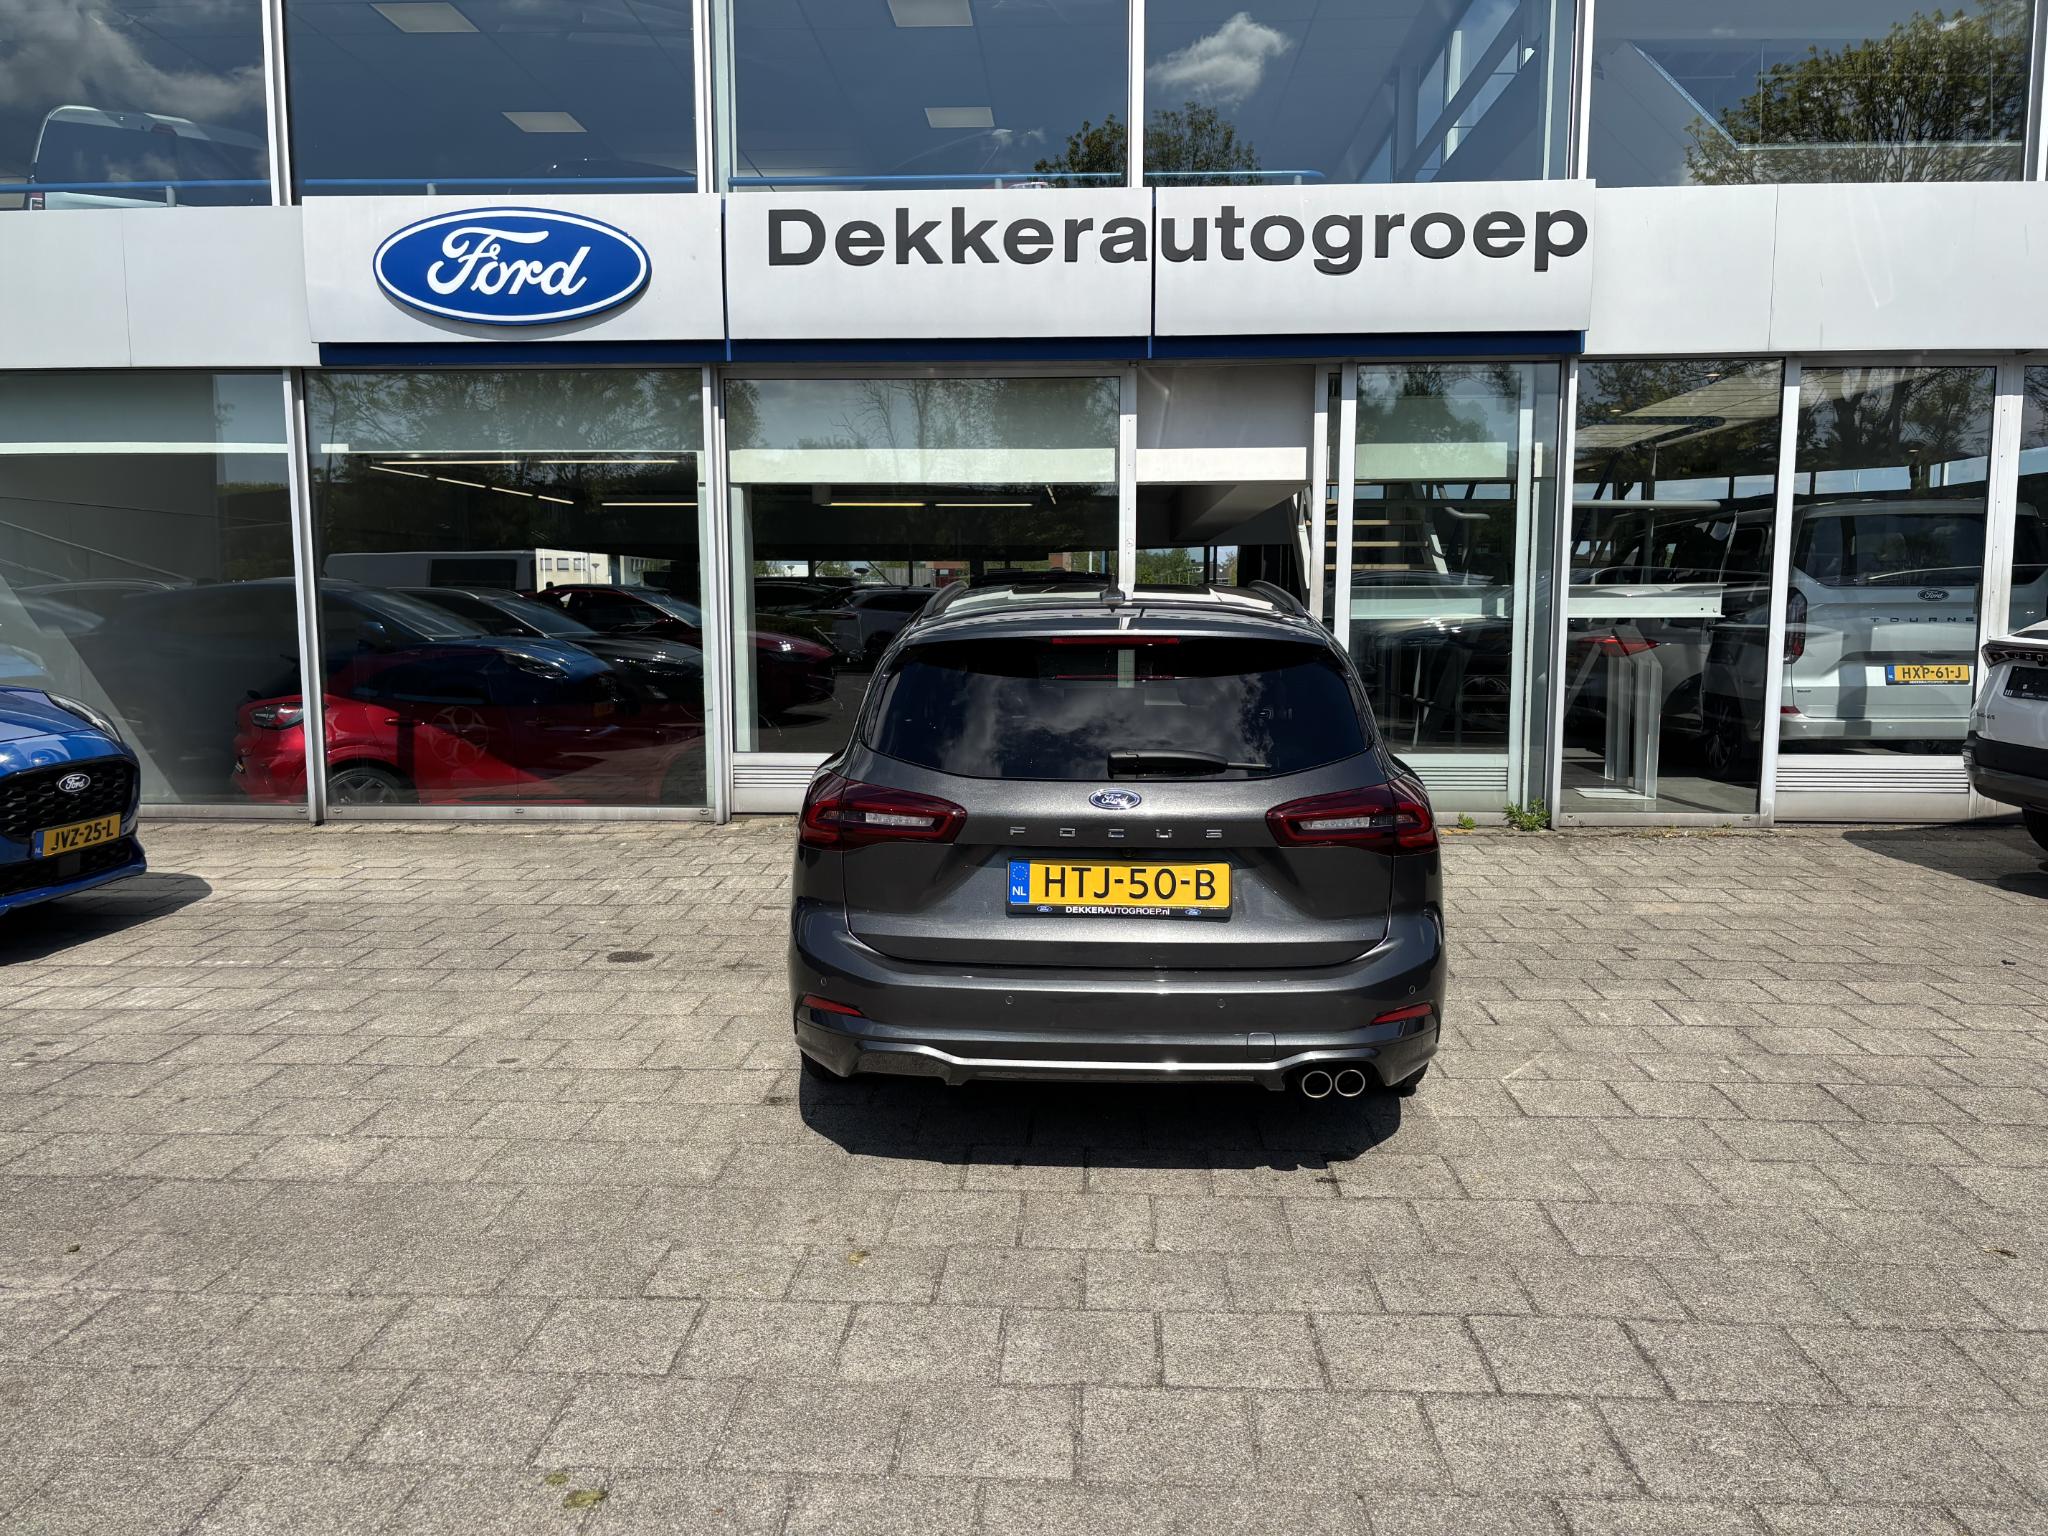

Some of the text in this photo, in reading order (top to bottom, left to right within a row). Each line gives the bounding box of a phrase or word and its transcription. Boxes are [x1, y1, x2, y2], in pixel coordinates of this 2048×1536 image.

[768, 205, 1589, 277] Dekkerautogroep
[426, 226, 592, 296] Ford
[1924, 591, 1944, 599] Ford
[1902, 667, 1962, 679] HXP-61-J
[65, 776, 85, 790] Ford
[1101, 793, 1130, 805] Ford
[50, 819, 114, 851] JVZ-25-L
[1009, 826, 1223, 839] FOCUS
[1044, 866, 1216, 901] HTJ-50-B
[1011, 886, 1027, 897] NL
[1065, 906, 1170, 916] DEKKERAUTOGROEP.nl
